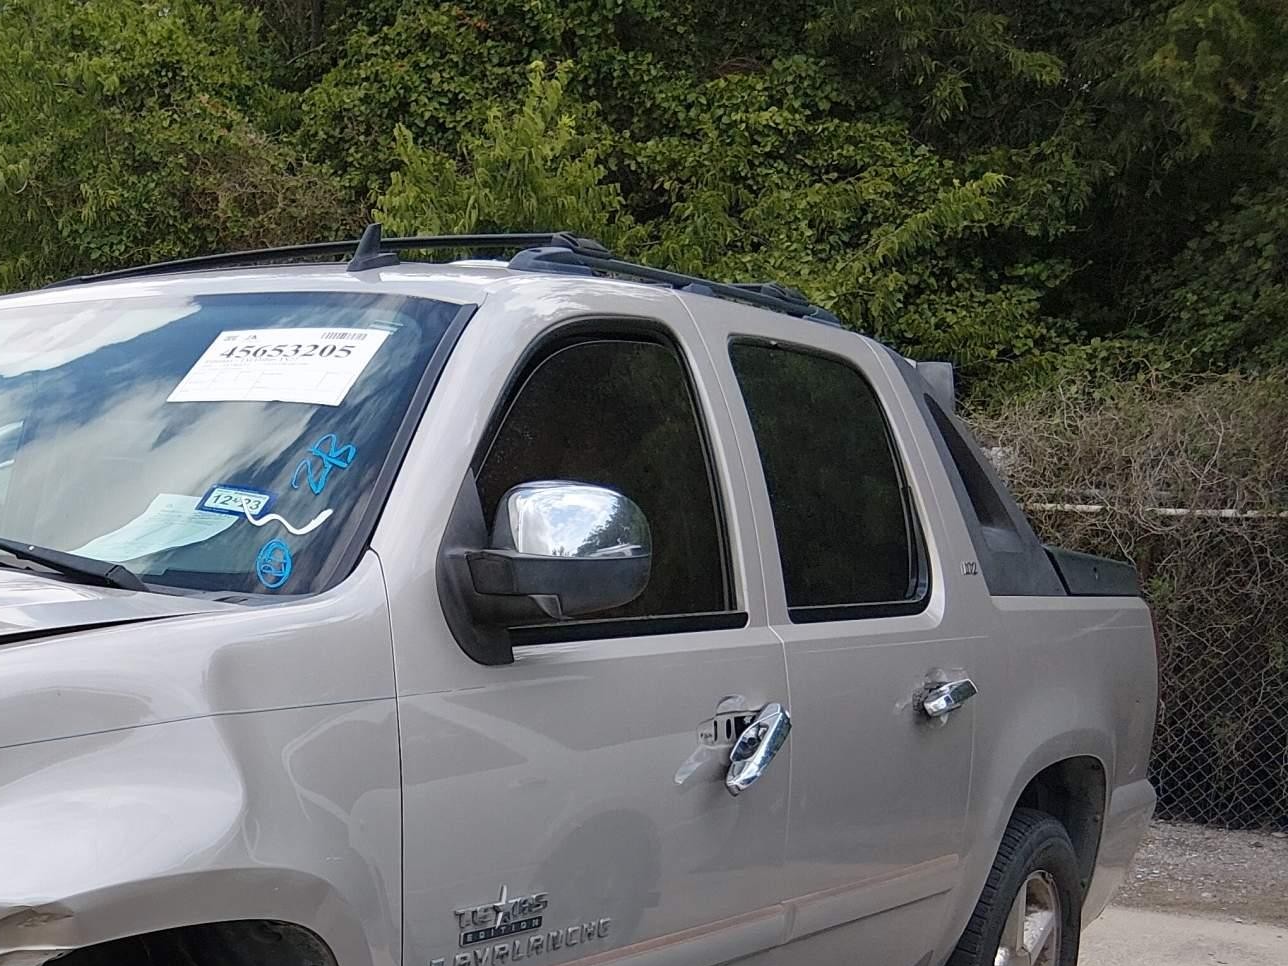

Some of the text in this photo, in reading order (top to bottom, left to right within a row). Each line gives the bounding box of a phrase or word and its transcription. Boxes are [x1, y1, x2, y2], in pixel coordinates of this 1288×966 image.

[220, 343, 357, 359] 45653205
[454, 890, 549, 929] TEXAS
[466, 917, 539, 942] EDITION
